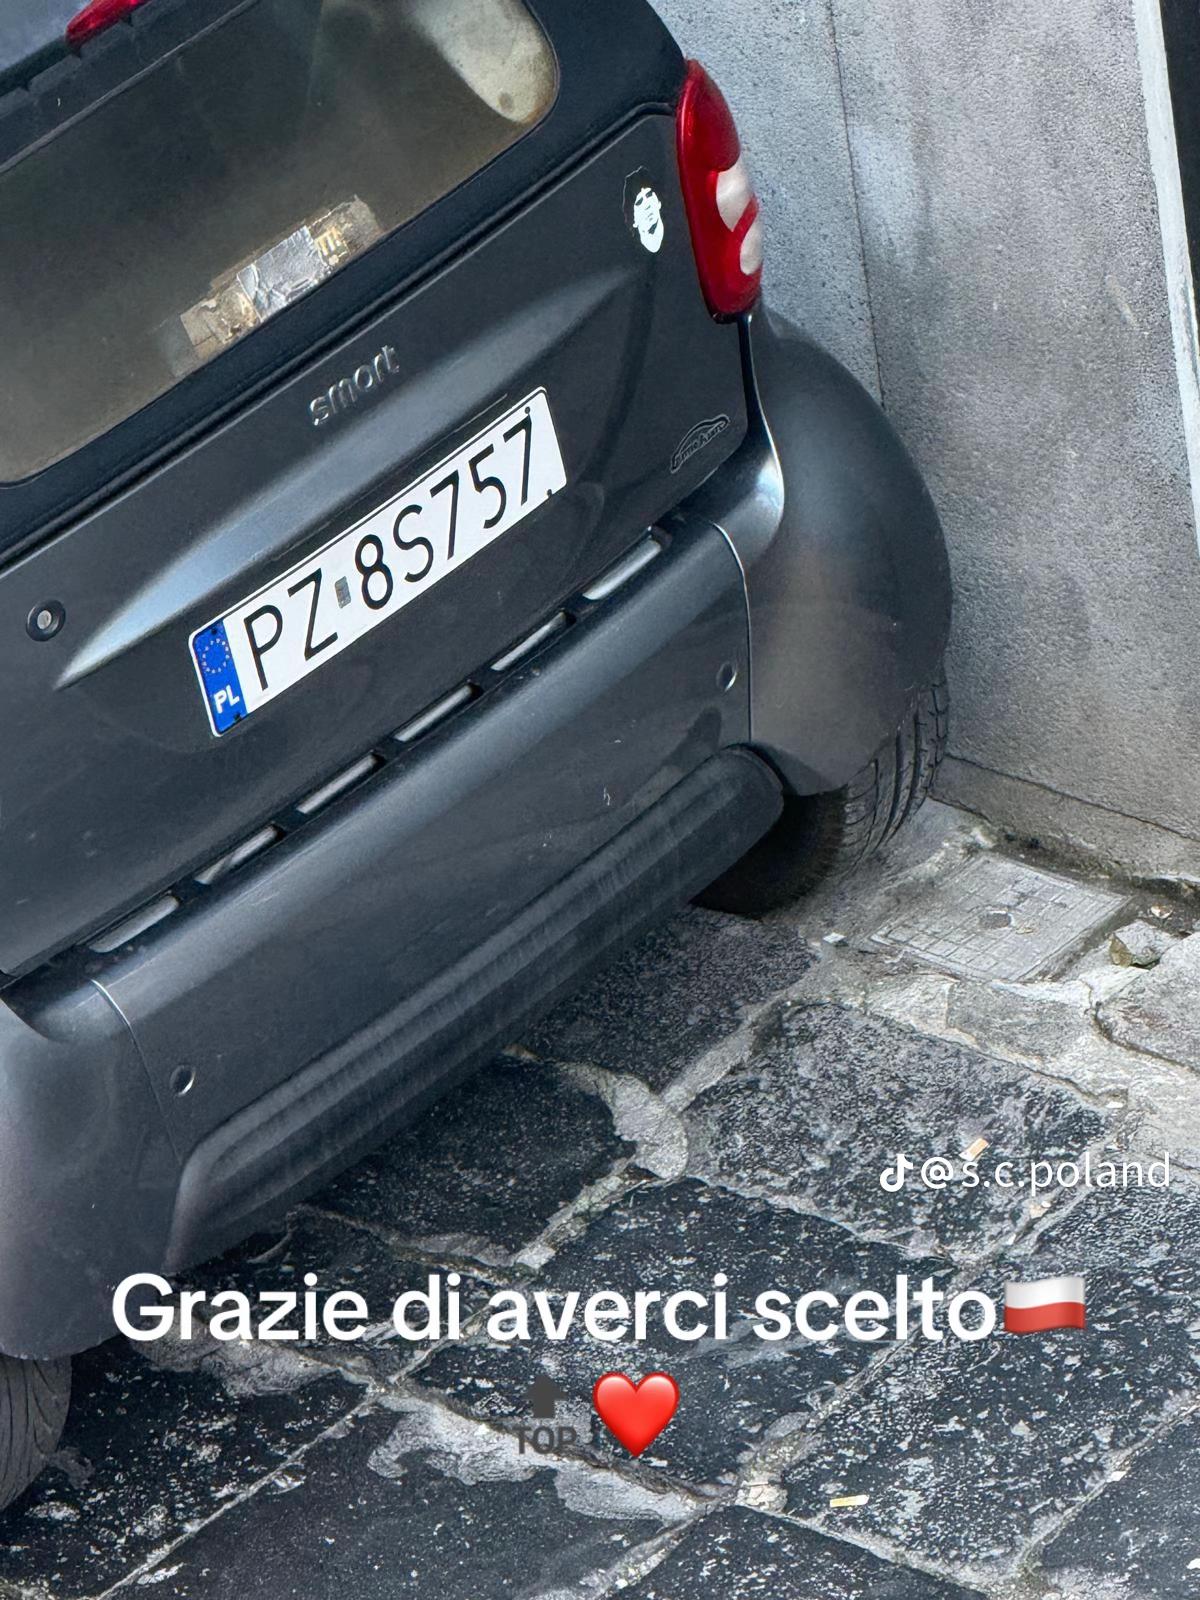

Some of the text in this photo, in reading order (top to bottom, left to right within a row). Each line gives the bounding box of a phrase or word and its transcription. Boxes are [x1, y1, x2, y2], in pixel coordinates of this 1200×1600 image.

[309, 345, 400, 426] smart
[243, 414, 532, 692] PZ 8S757
[213, 684, 240, 714] PL
